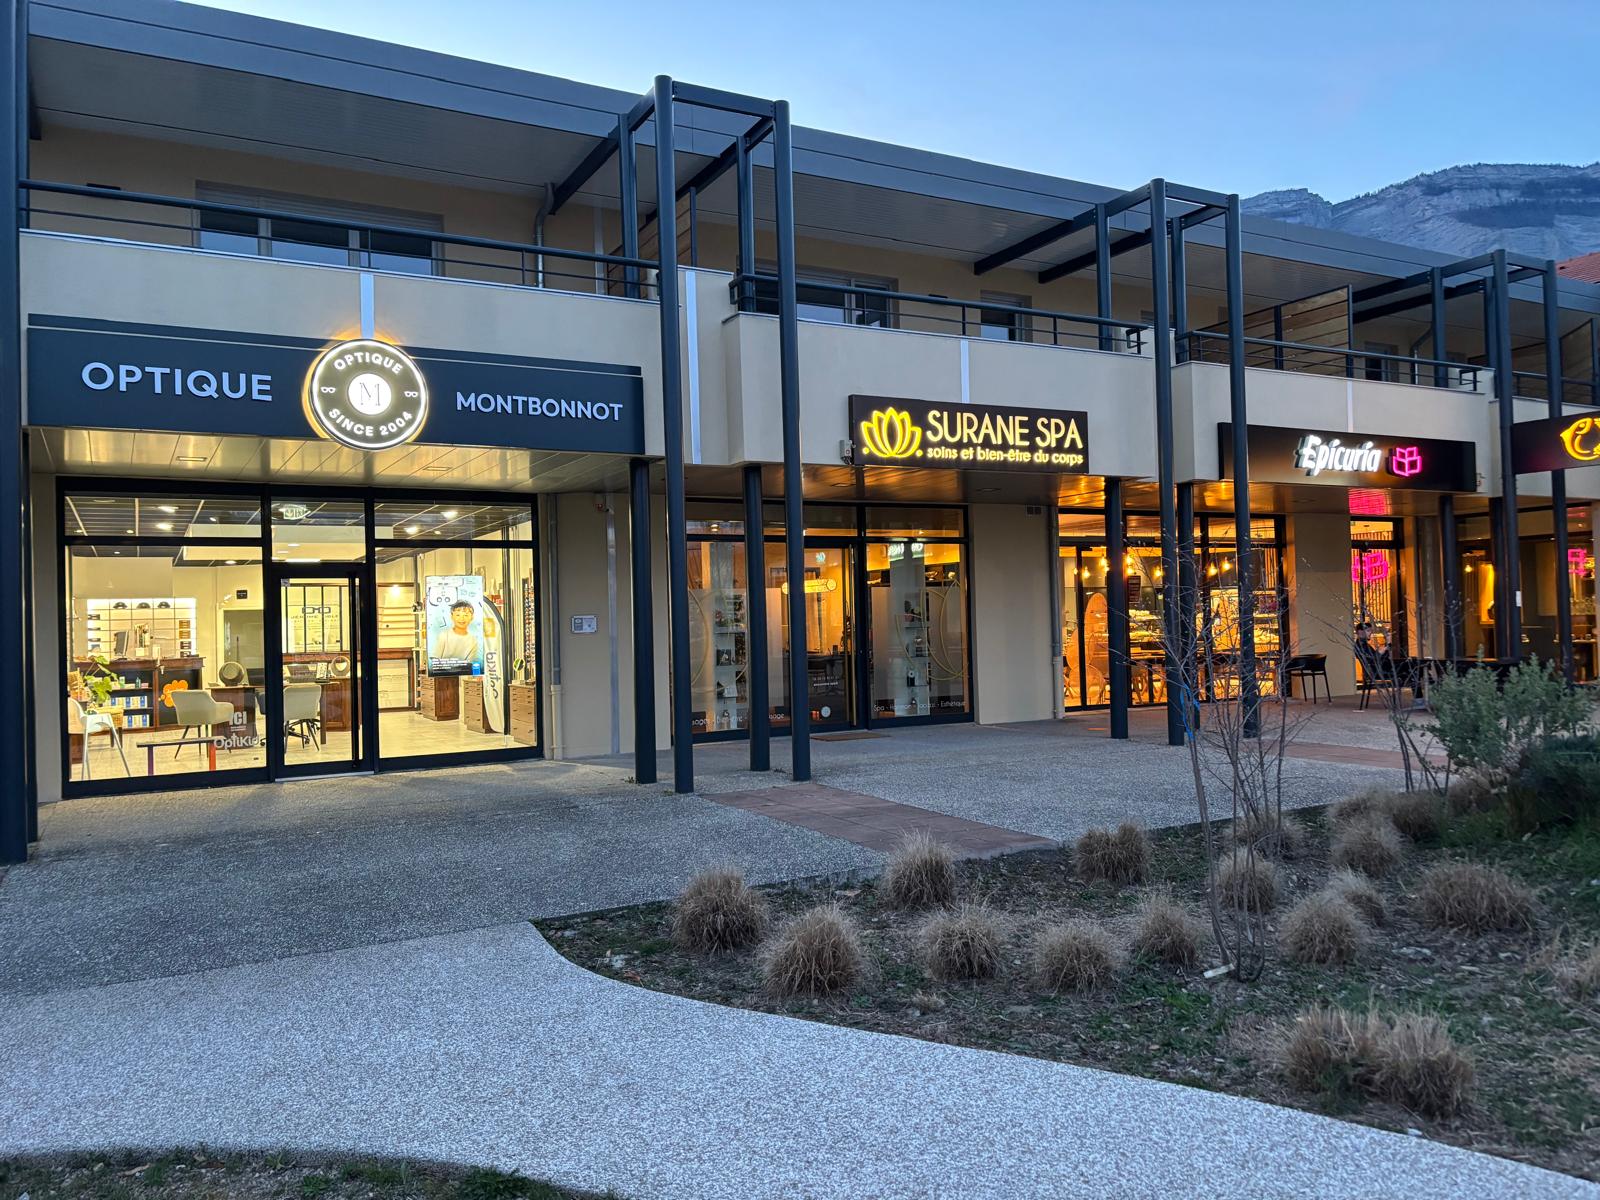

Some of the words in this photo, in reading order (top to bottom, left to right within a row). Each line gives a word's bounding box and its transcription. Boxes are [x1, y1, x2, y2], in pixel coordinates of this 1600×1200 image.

[333, 352, 403, 374] OPTIQUE
[81, 361, 273, 402] OPTIQUE
[359, 382, 381, 406] M
[456, 391, 624, 421] MONTBONNOT
[328, 408, 374, 436] SINCE
[379, 411, 413, 435] 2004
[926, 409, 1030, 446] SURANE
[1035, 417, 1084, 449] SPA
[926, 446, 958, 459] soins
[960, 447, 974, 461] et
[977, 447, 1031, 463] bien-être
[1033, 450, 1049, 463] du
[1051, 453, 1084, 467] corps
[1294, 434, 1382, 477] Epicuria
